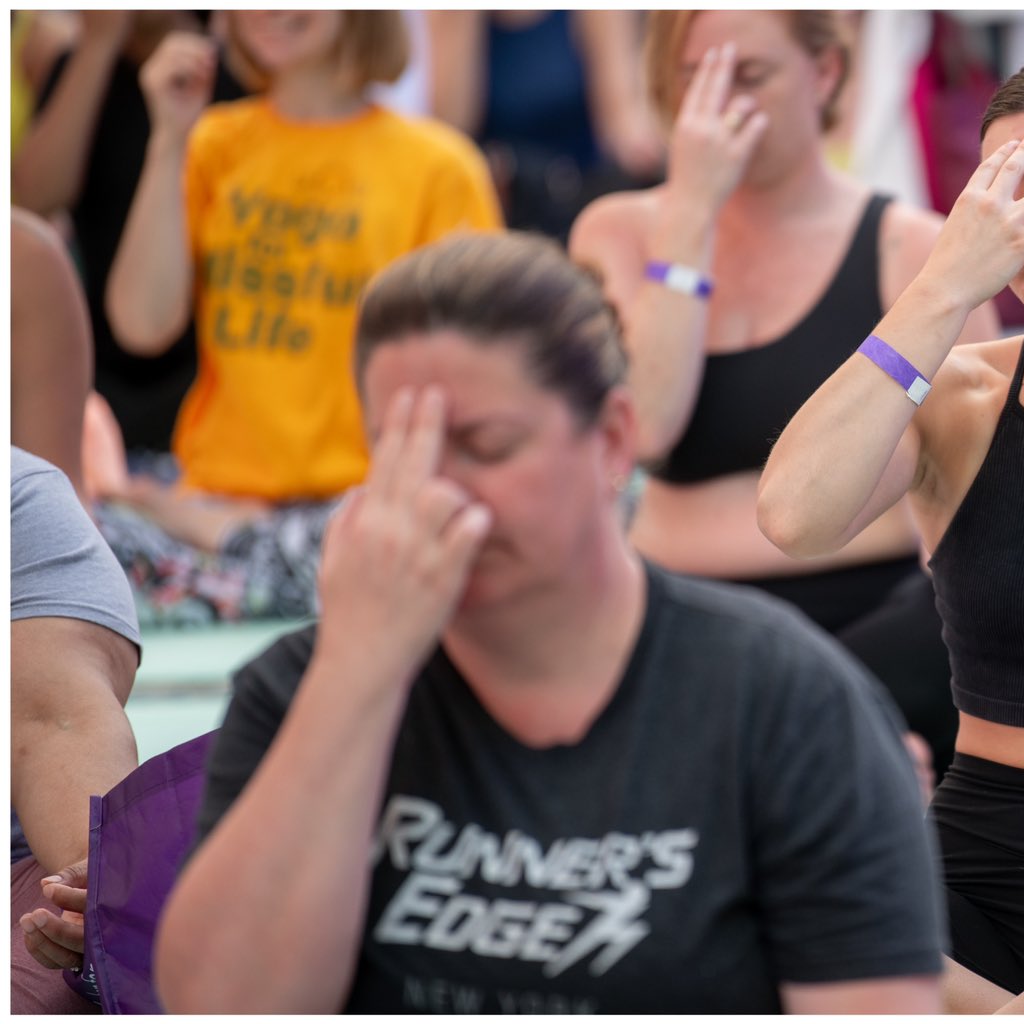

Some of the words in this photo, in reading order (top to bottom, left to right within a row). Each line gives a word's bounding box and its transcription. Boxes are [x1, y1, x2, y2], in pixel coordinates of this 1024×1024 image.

[231, 187, 361, 249] Yoga
[214, 304, 312, 355] Life
[371, 794, 698, 890] RUNNER'S
[374, 869, 583, 963] EDGE
